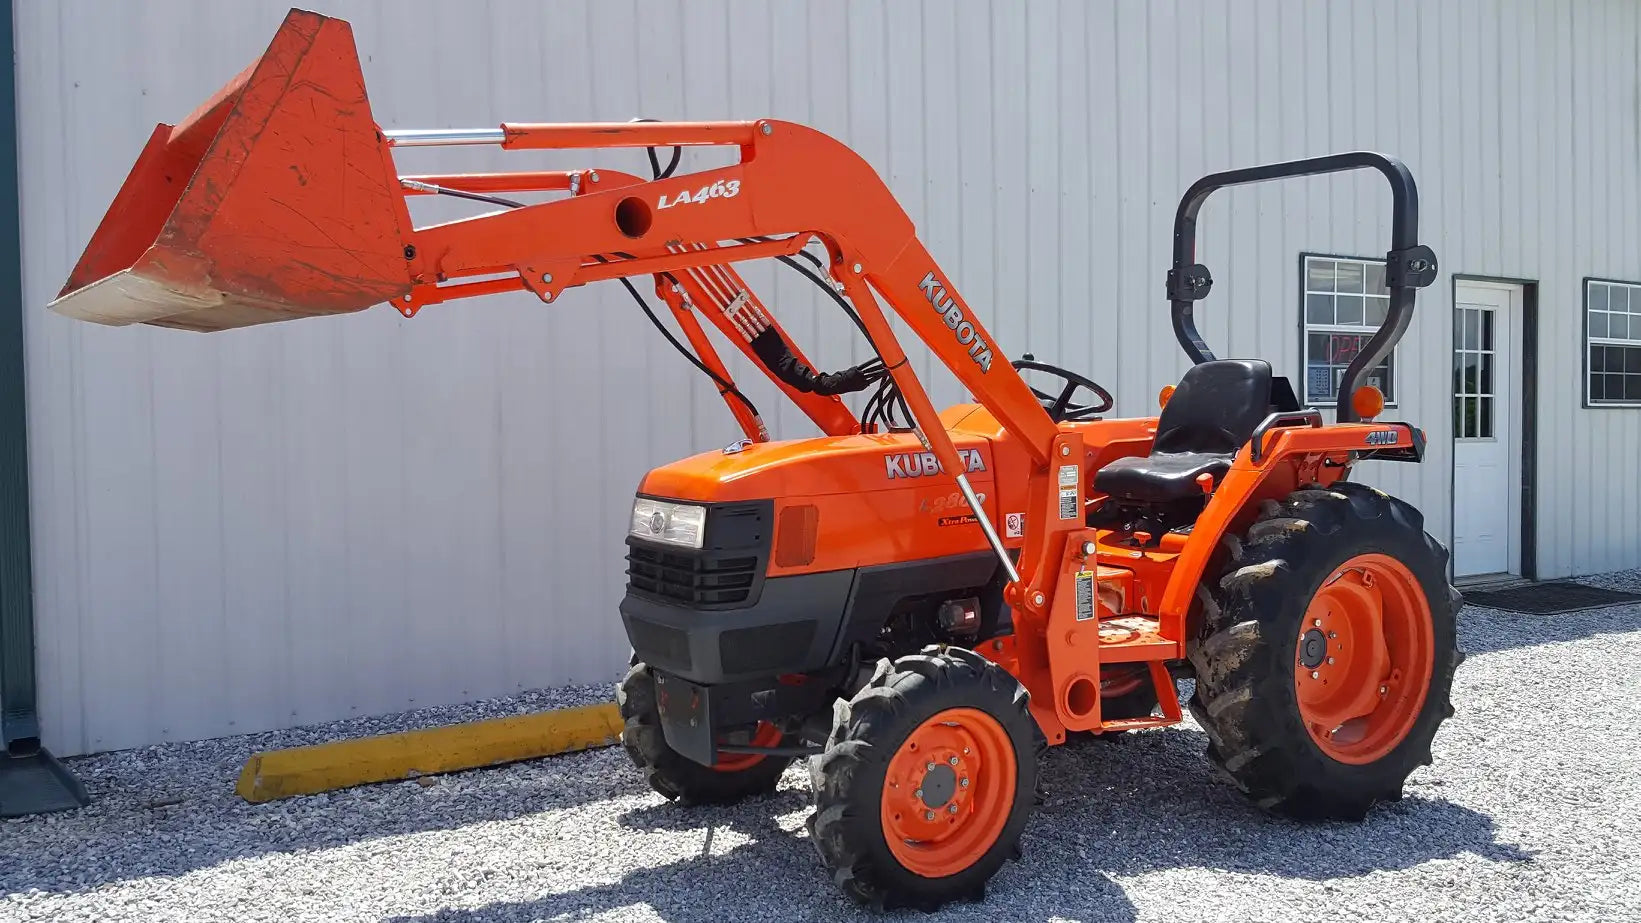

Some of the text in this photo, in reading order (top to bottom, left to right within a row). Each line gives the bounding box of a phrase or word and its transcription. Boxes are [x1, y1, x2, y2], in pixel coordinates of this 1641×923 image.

[657, 180, 741, 210] LA463
[918, 271, 993, 374] KUBOTA
[1326, 335, 1361, 362] OPE
[1365, 431, 1398, 445] 4WD
[885, 449, 987, 479] KUBTA
